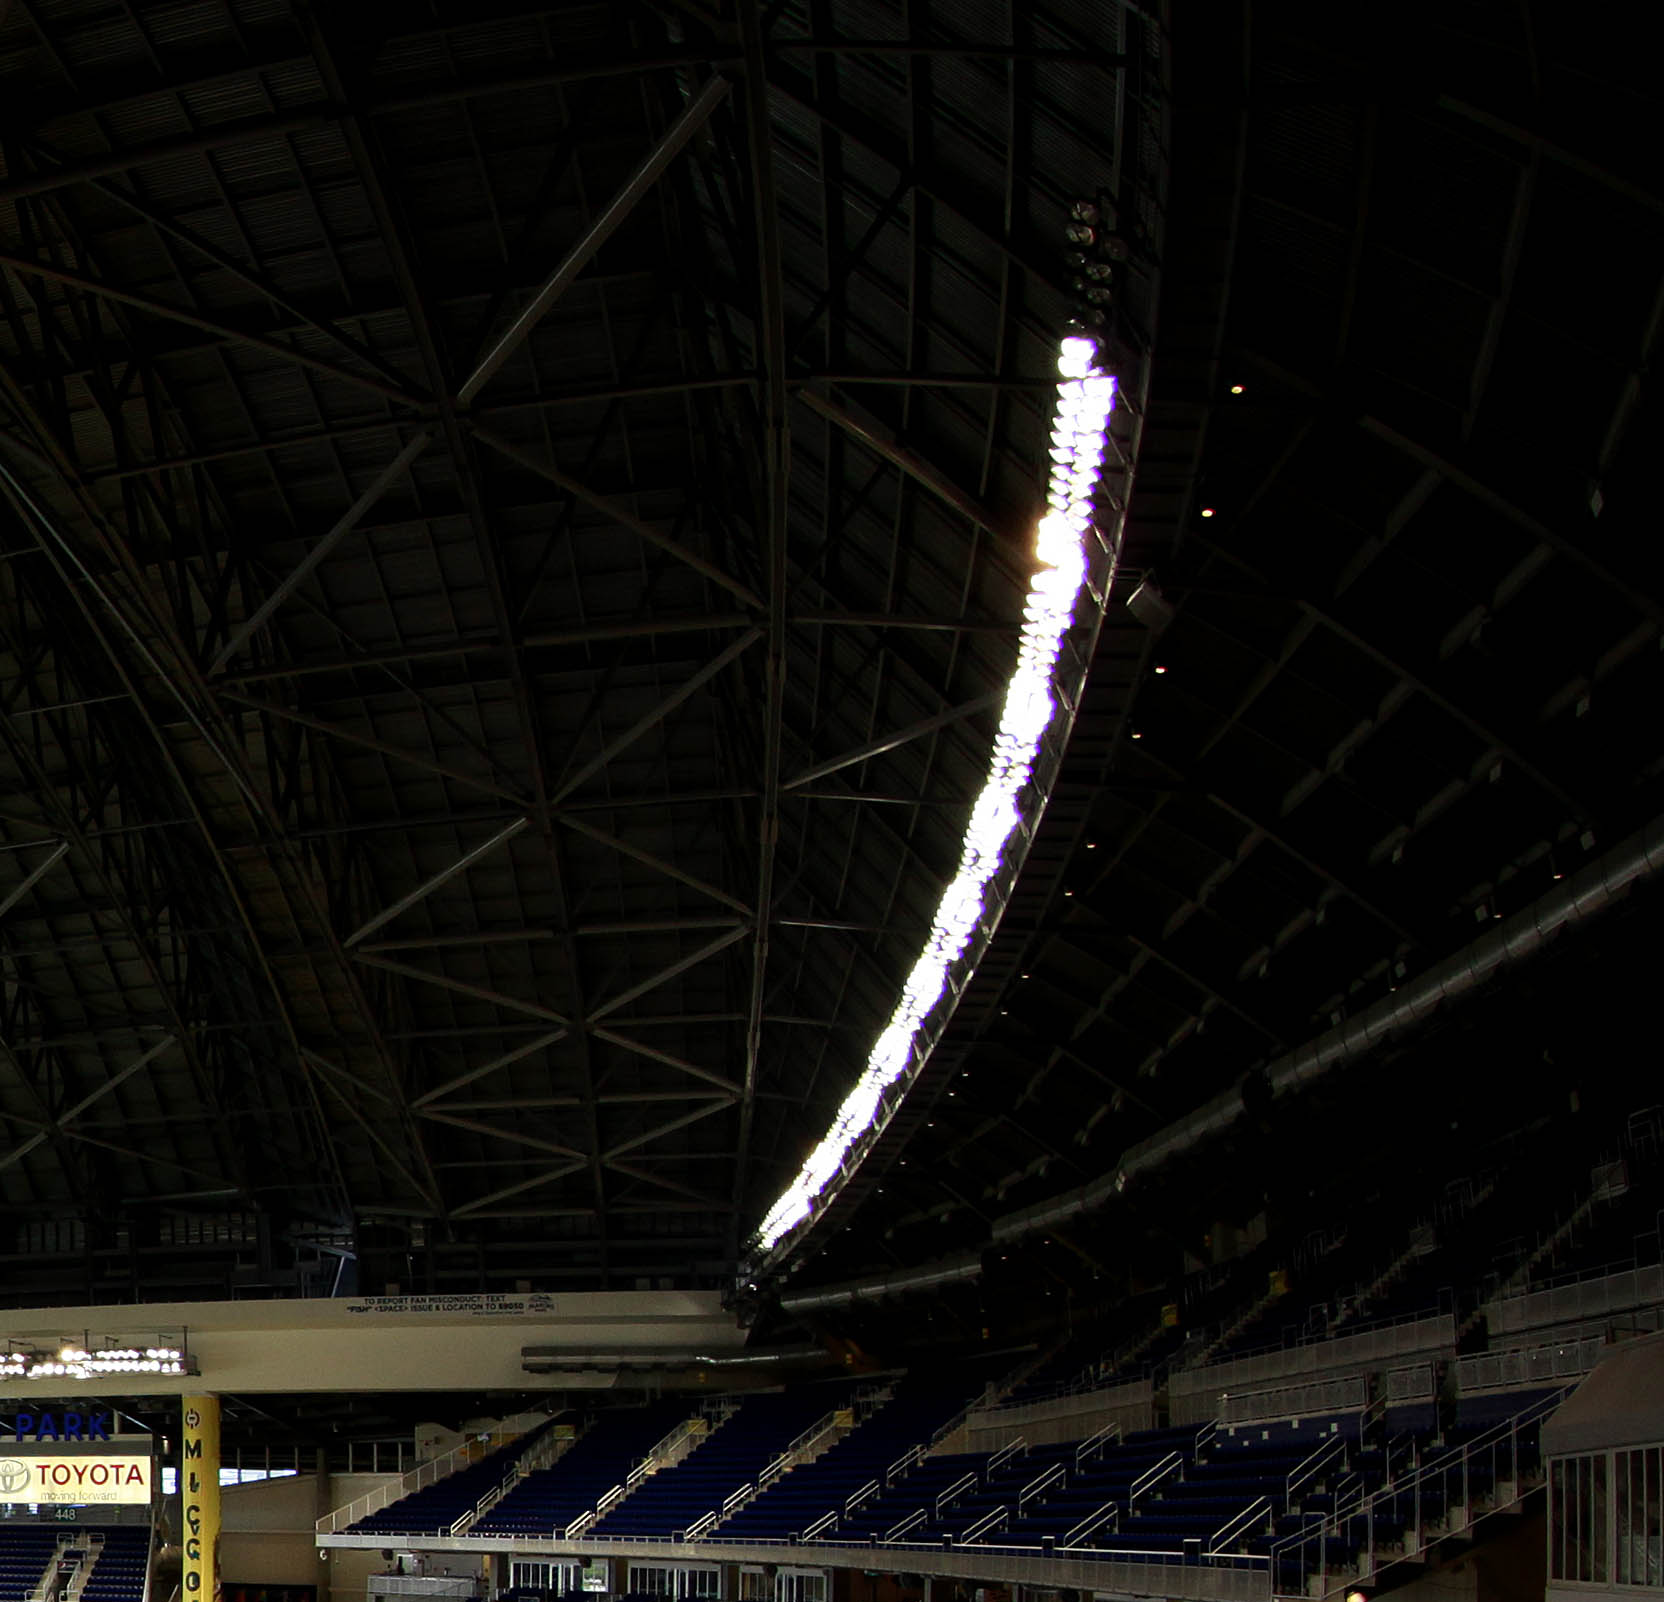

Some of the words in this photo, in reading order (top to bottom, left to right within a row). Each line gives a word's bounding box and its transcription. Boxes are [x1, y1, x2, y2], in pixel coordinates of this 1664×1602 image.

[16, 1412, 111, 1442] PARK
[35, 1464, 145, 1486] TOYOTA
[40, 1491, 76, 1502] moving
[78, 1490, 117, 1501] forward
[55, 1509, 76, 1521] 448
